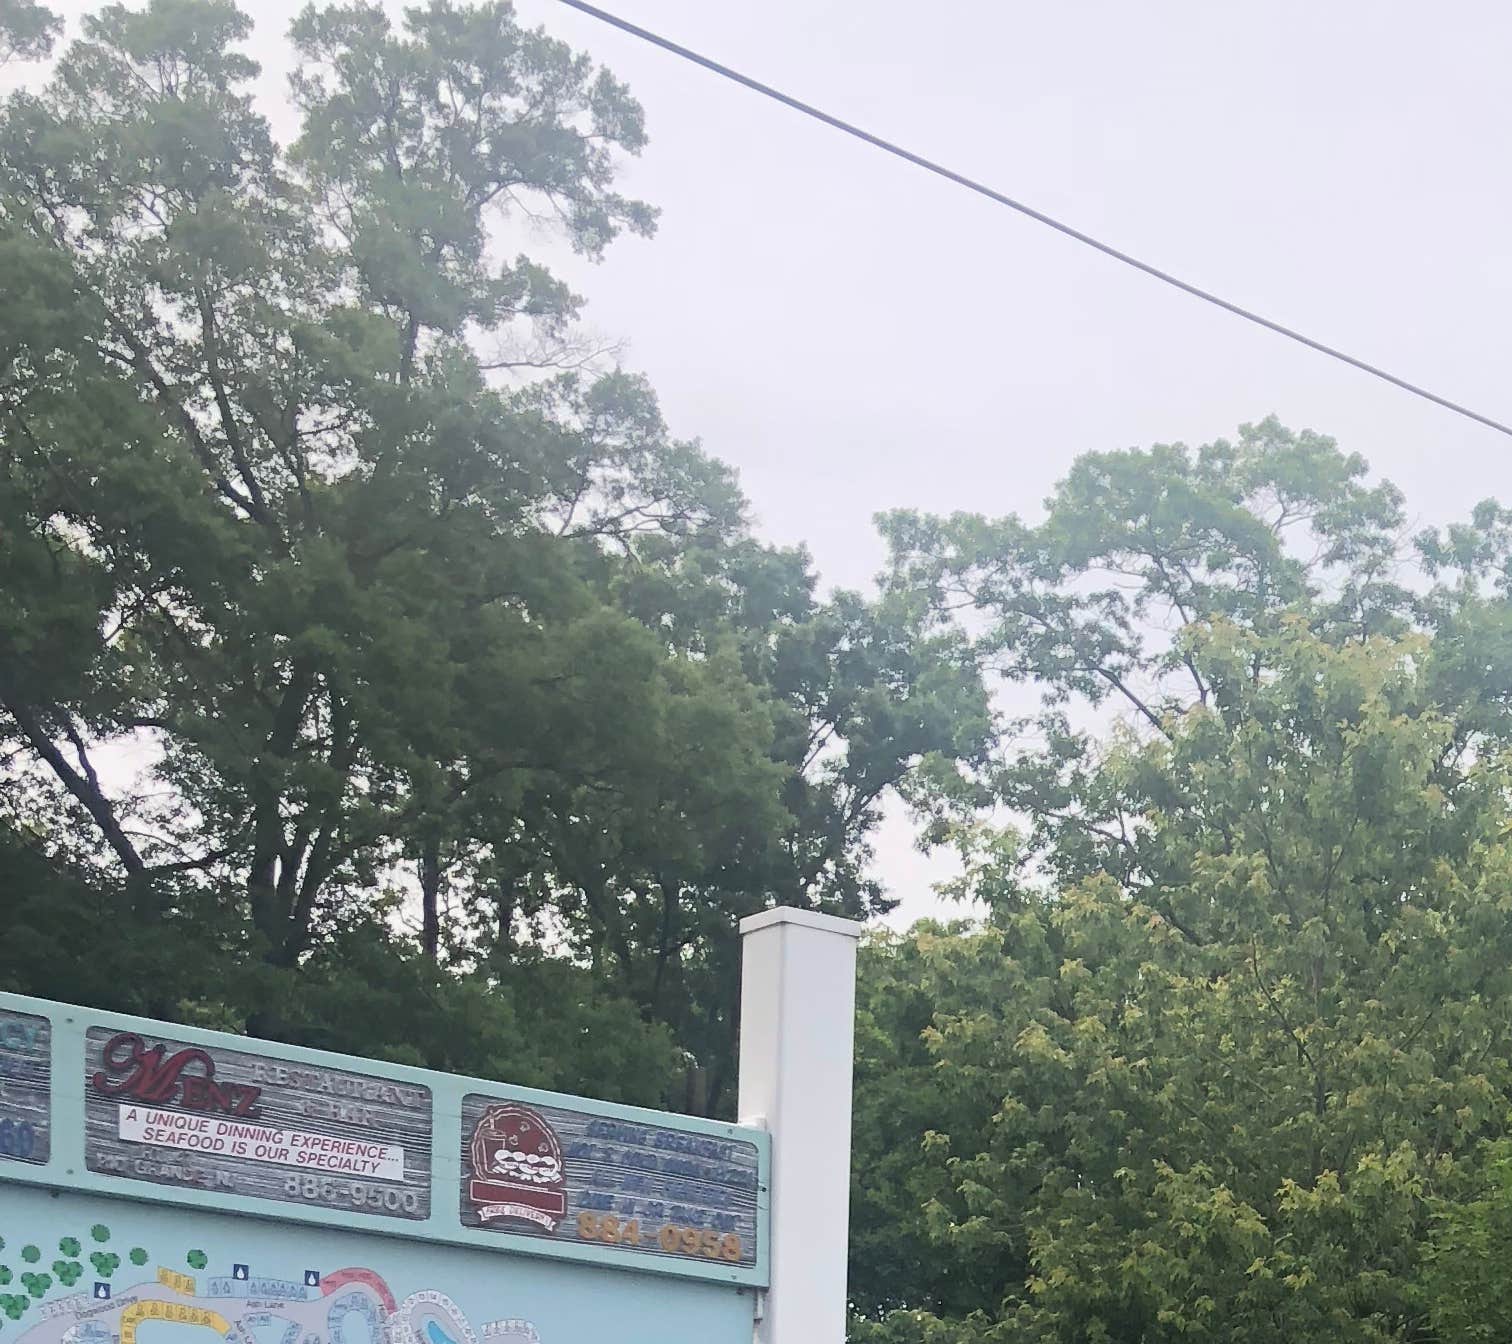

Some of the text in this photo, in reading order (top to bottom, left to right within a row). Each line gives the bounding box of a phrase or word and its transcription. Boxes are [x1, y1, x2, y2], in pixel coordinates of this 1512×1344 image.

[126, 1108, 399, 1162] A UNIQUE DINNING EXPERIENCE...
[143, 1127, 382, 1175] SEAFOOD IS OUR SPECIALTY
[283, 1175, 419, 1213] 886-9500
[577, 1211, 742, 1261] 884-0958
